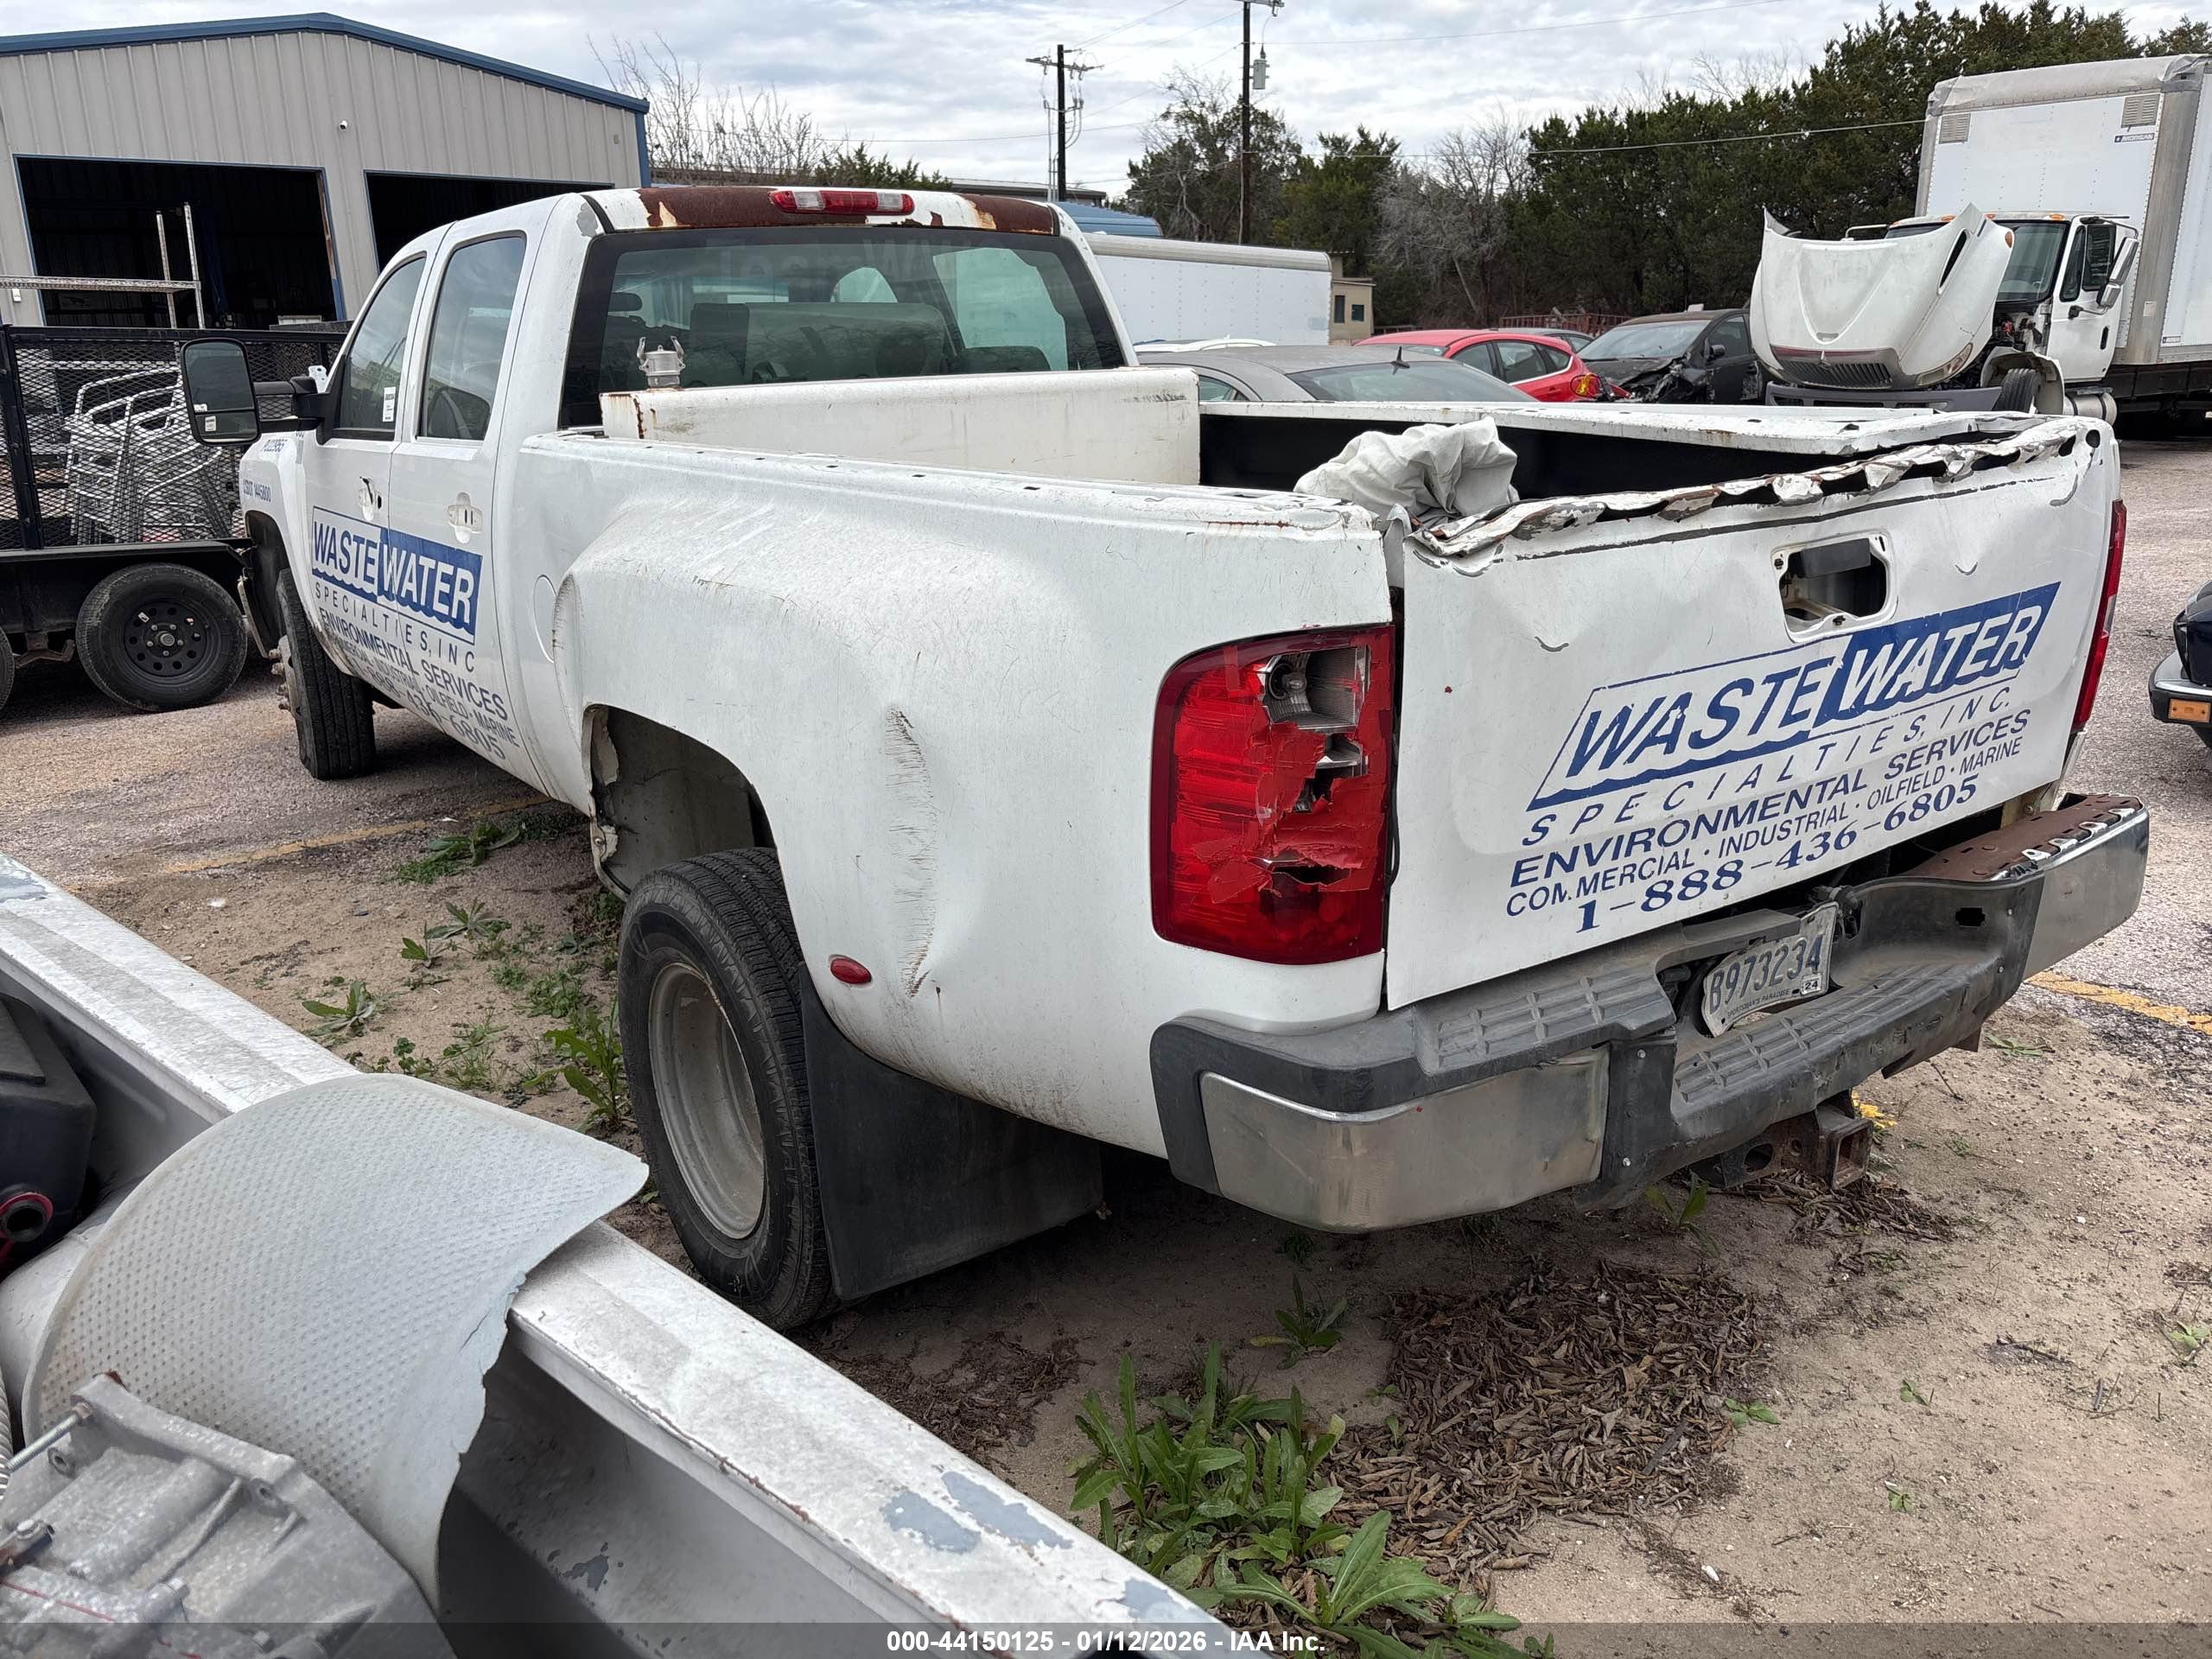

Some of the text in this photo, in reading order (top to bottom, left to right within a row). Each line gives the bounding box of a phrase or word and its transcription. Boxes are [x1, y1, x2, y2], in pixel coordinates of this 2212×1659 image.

[319, 607, 508, 721] ENVIRONMENTAL SERVICES
[473, 709, 520, 748] MARINE
[1510, 709, 2031, 888] ENVIRONMENTAL SERVICES
[1576, 773, 1980, 934] 1-888-436-6805
[1718, 802, 1848, 859] INDUSTRIAL
[1866, 765, 1945, 810] OILFIELD
[1959, 736, 2023, 775] MARINE
